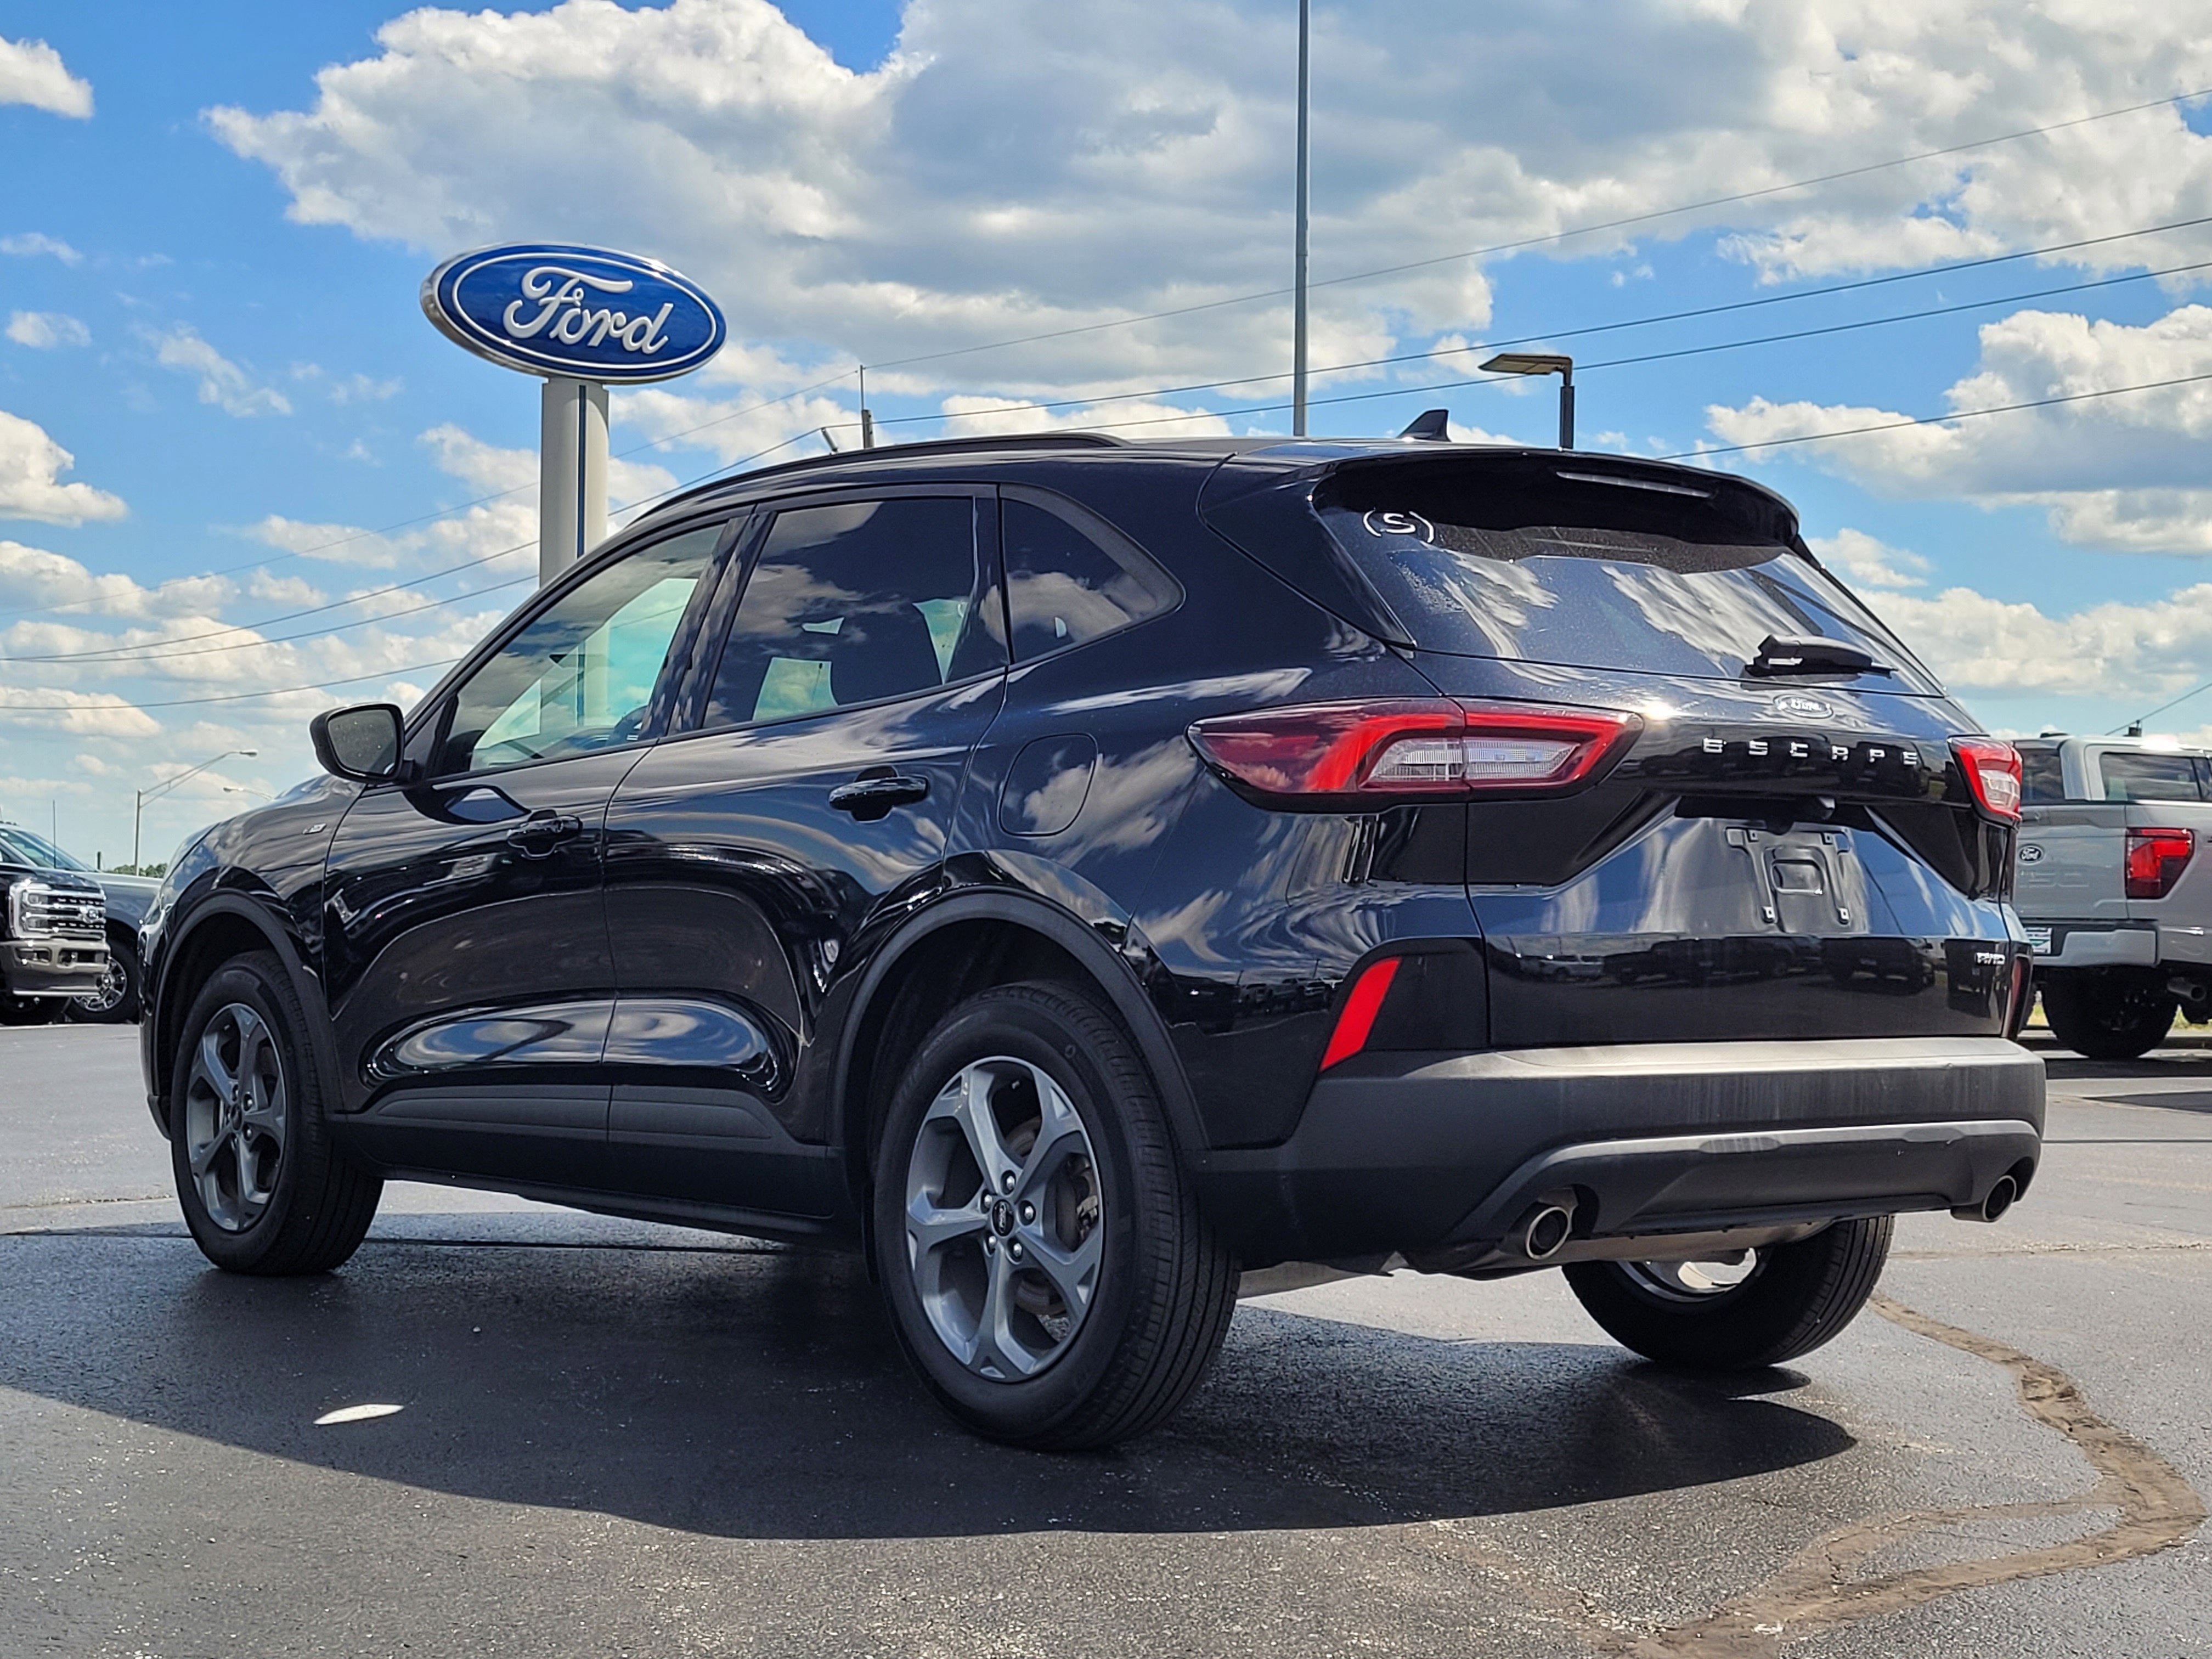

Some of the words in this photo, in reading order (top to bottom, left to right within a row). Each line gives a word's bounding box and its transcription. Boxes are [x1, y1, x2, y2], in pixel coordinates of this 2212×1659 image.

[503, 266, 674, 354] Ford
[1702, 737, 1918, 765] ESCAPE
[2021, 848, 2039, 860] Ford
